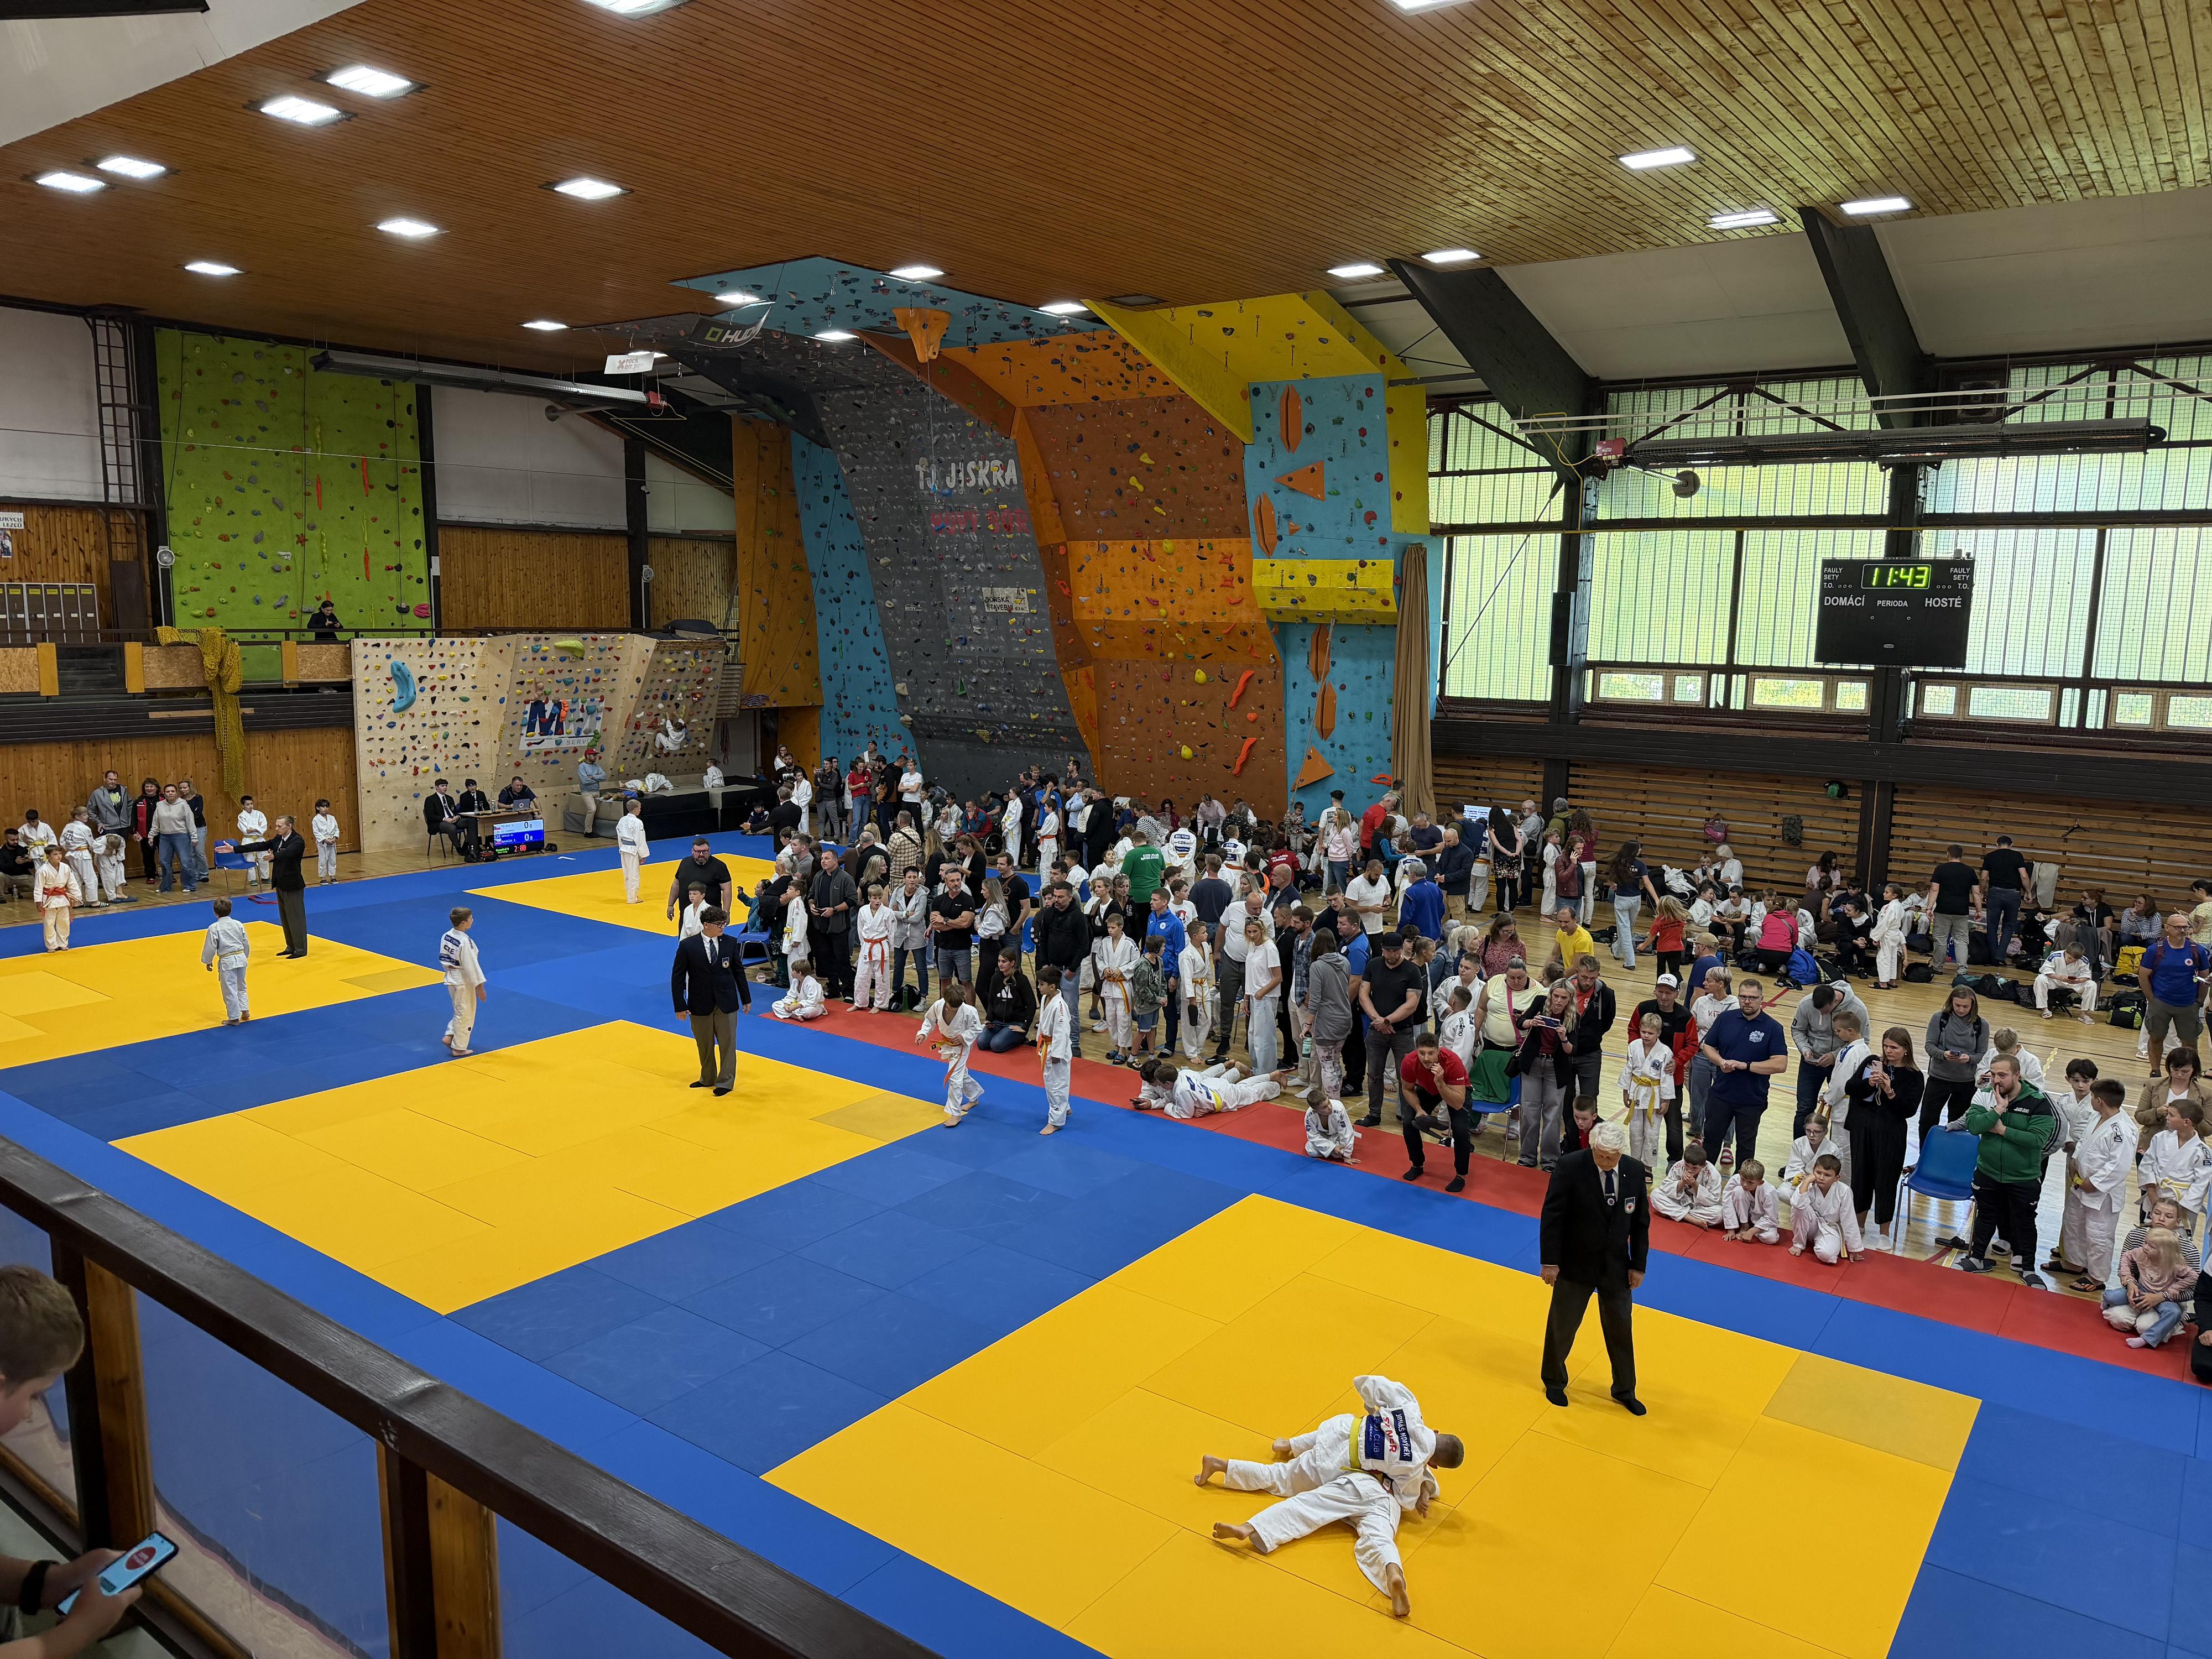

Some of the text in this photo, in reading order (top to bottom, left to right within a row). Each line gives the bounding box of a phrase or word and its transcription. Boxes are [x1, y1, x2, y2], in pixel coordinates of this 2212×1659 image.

[946, 458, 1018, 489] JISKRA
[1871, 567, 1930, 588] 11:43
[1824, 594, 1866, 606] DOMÁCÍ
[1925, 596, 1962, 608] HOSTÉ
